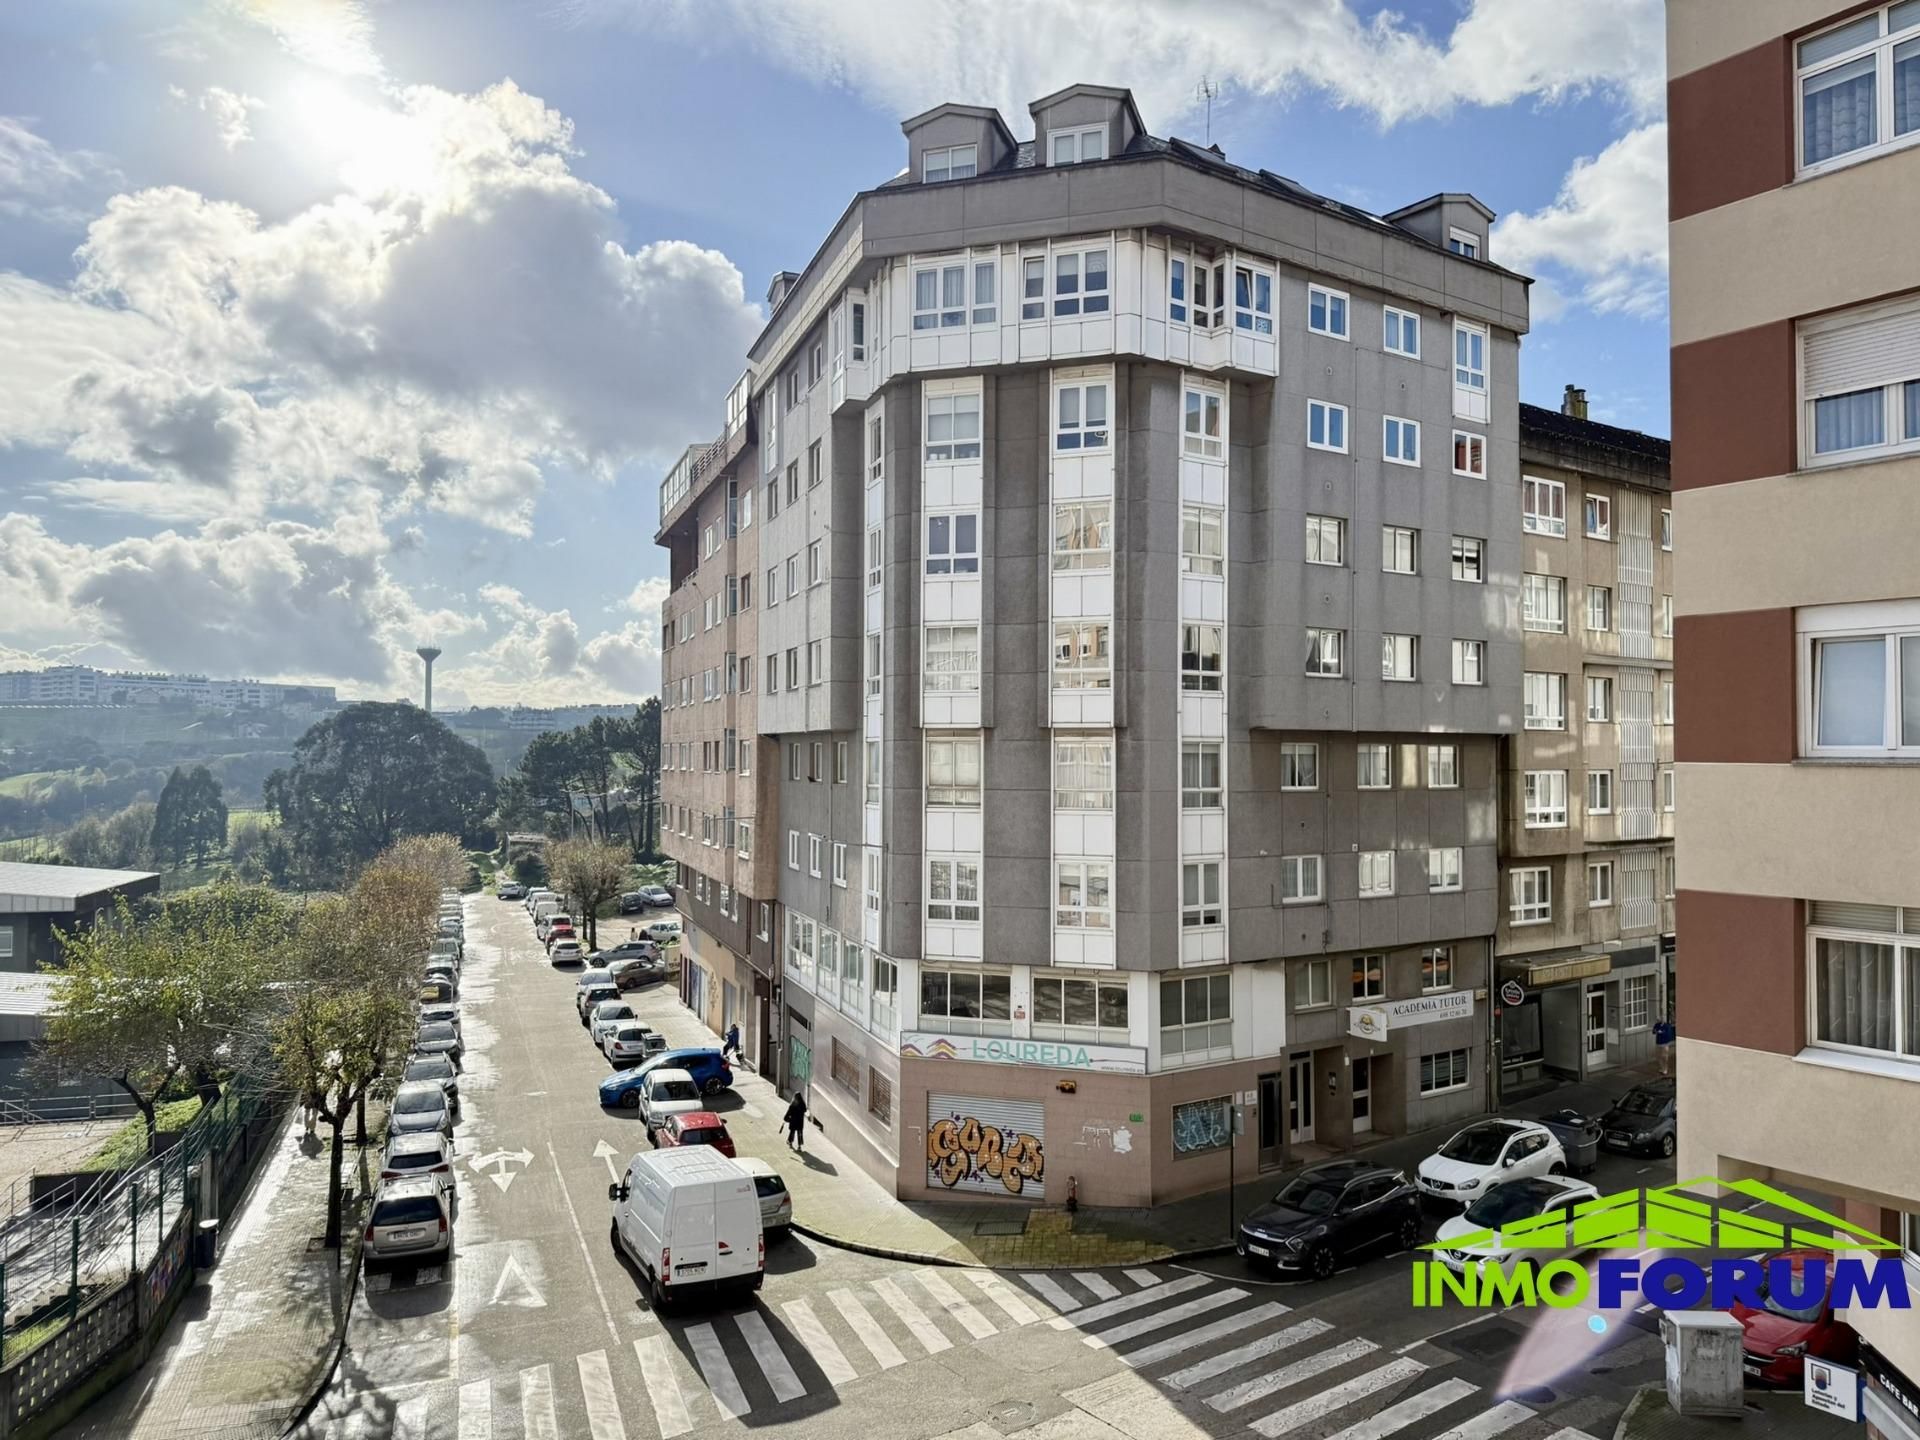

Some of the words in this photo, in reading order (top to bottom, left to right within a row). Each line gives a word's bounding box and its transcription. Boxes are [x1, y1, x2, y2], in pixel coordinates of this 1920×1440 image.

[1393, 1000, 1437, 1016] ACADEMIA
[1439, 995, 1467, 1009] TUTOR
[972, 1039, 1091, 1068] LOUREDA
[1880, 1373, 1901, 1400] CAFE
[1902, 1395, 1919, 1418] BAR
